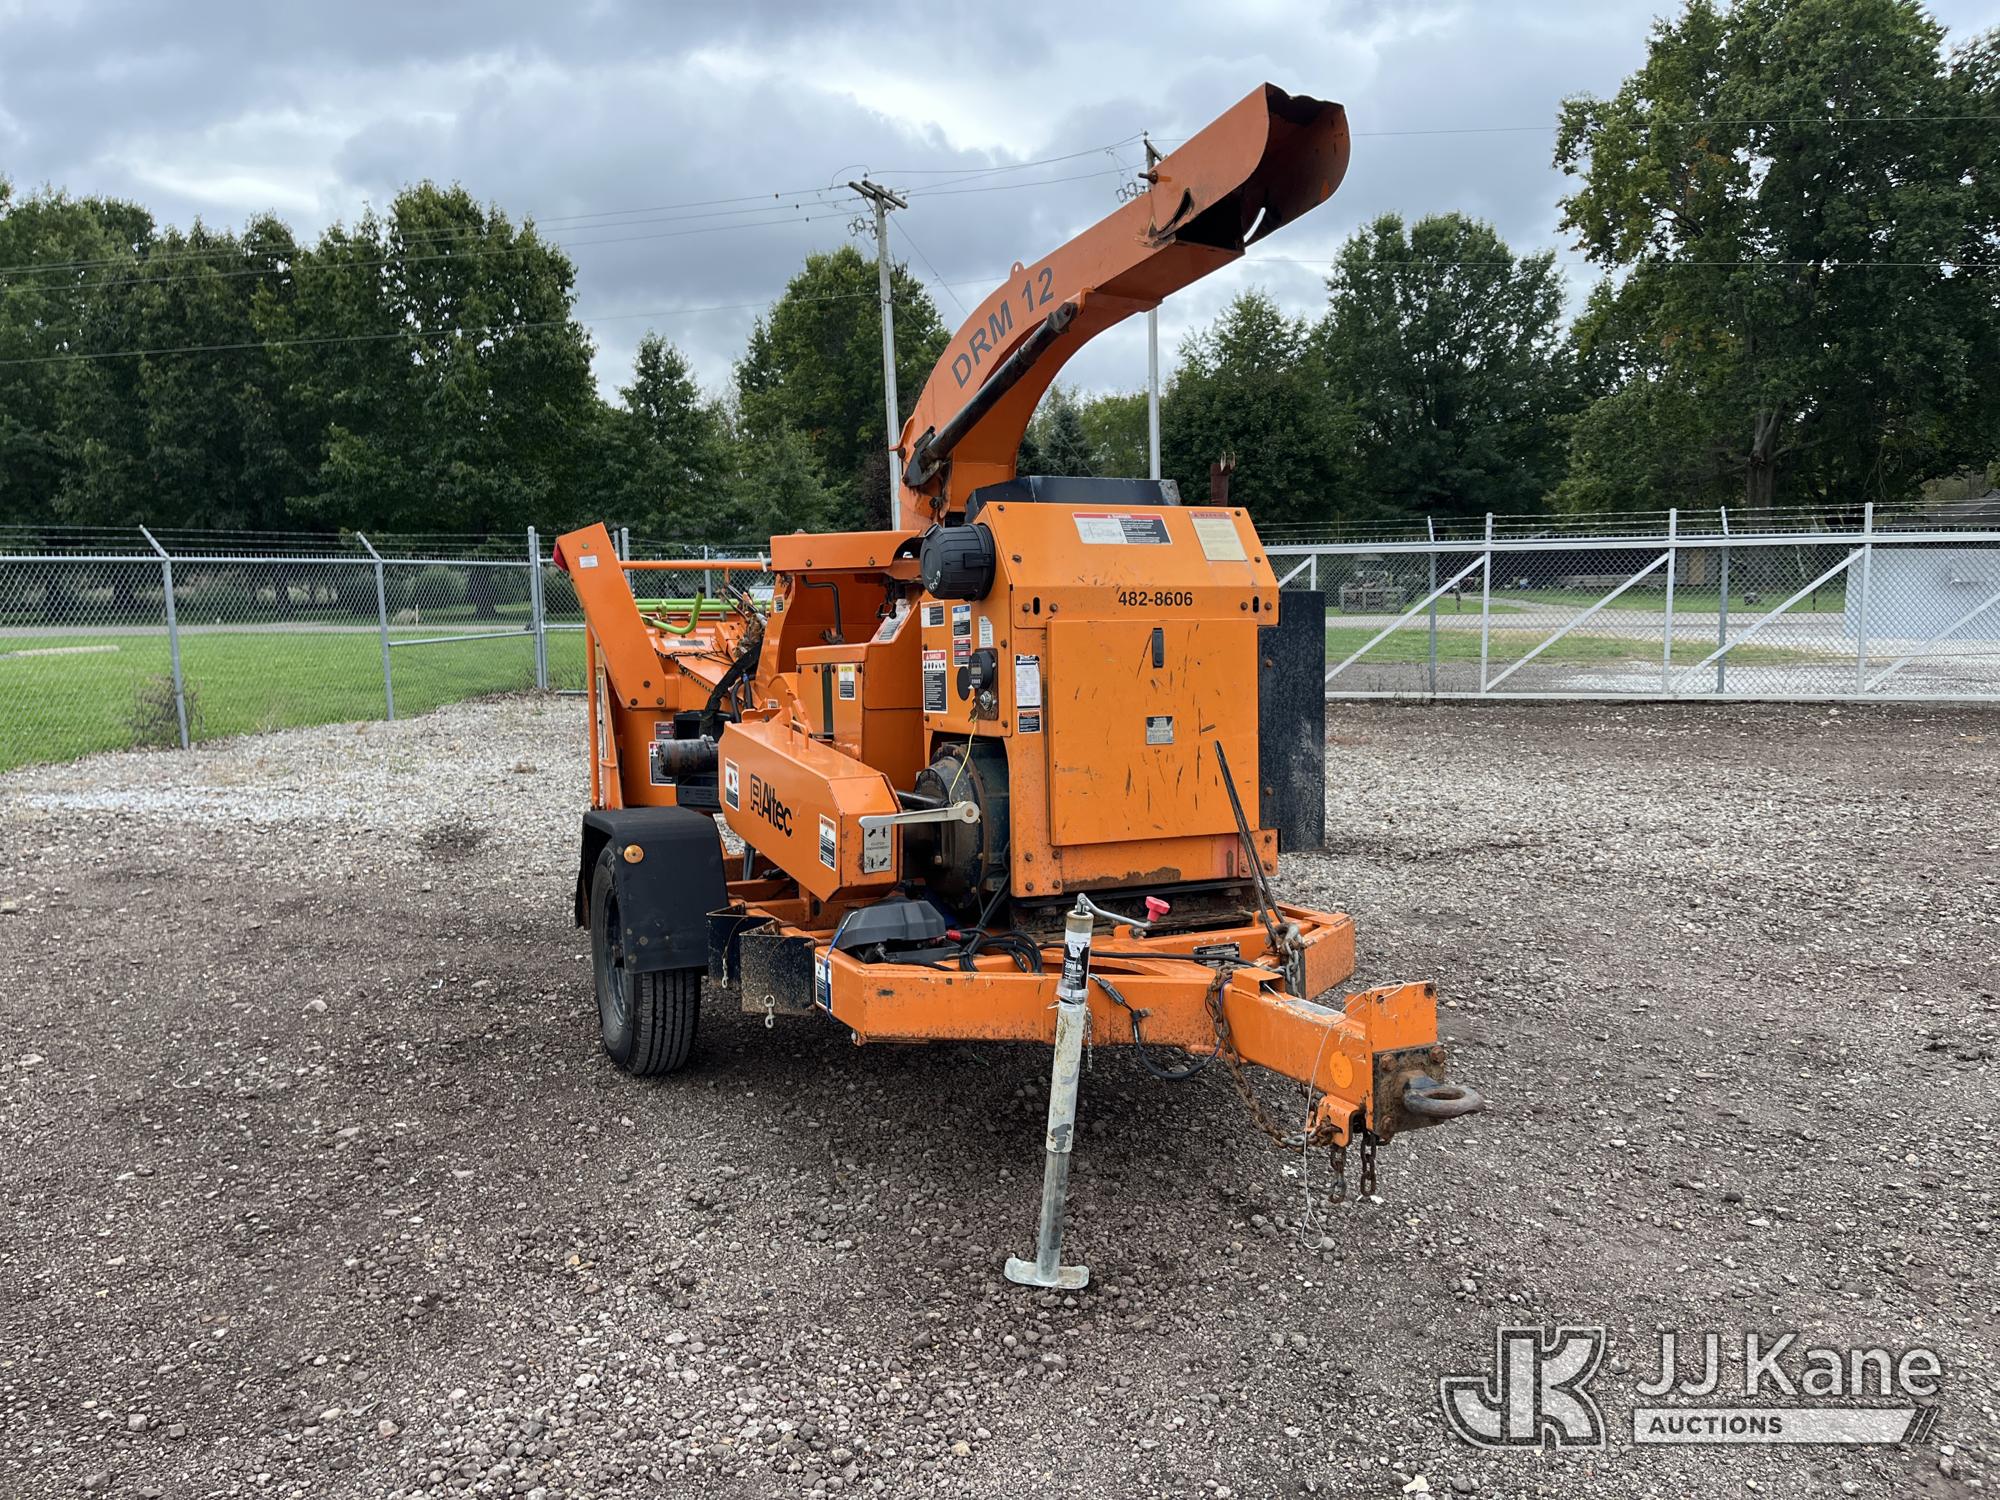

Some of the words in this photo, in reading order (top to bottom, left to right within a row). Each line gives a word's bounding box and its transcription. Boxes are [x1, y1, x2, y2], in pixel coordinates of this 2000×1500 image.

[952, 300, 1013, 389] DRM
[1021, 267, 1054, 313] 12
[1118, 591, 1193, 607] 482-8606
[761, 782, 793, 838] Altec
